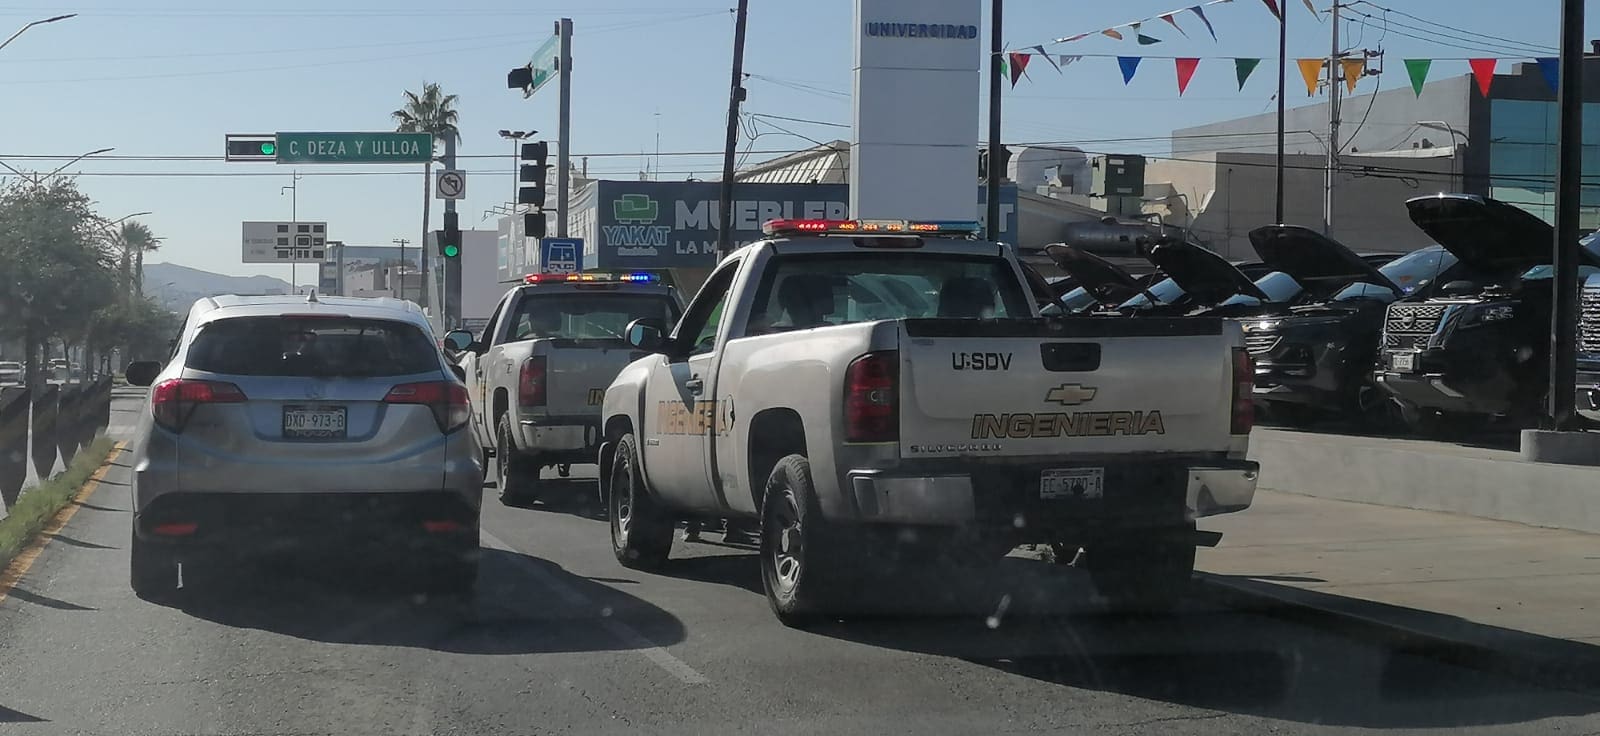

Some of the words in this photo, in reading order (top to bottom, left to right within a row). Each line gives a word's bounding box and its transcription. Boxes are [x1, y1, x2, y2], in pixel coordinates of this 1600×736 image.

[866, 22, 978, 40] UNIVERSIDAD
[289, 140, 301, 157] C.
[308, 140, 345, 156] DEZA
[355, 140, 365, 156] Y
[372, 140, 420, 156] ULLOA
[602, 225, 671, 247] YAKAT
[676, 241, 698, 254] LA
[971, 410, 1166, 439] INGENIERIA
